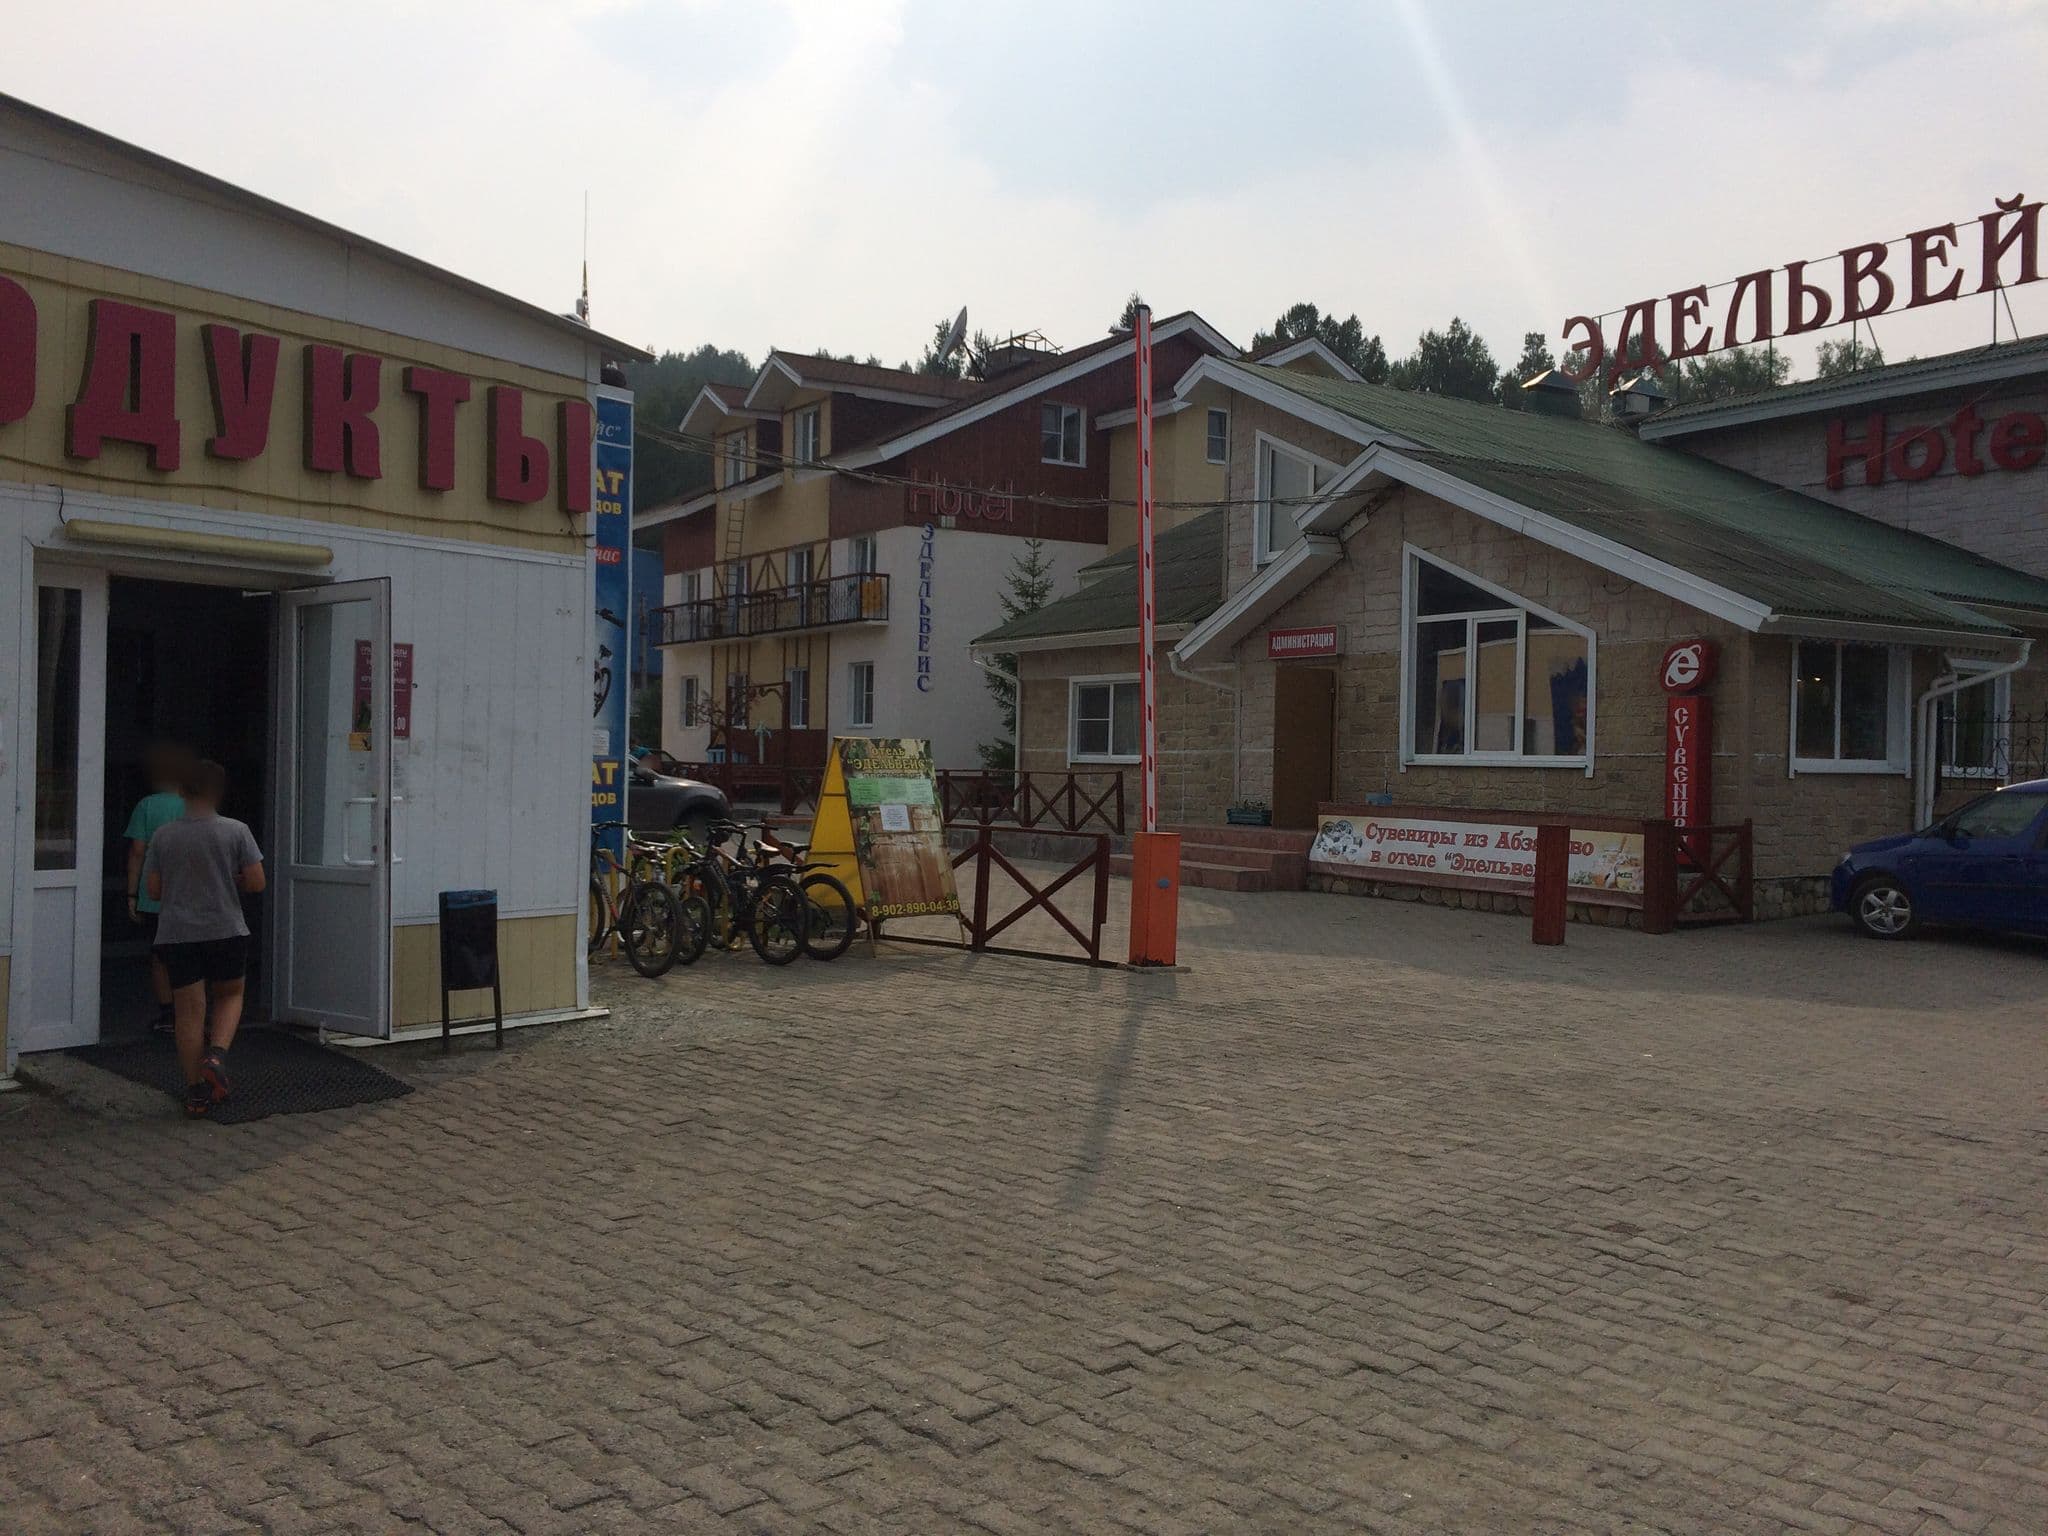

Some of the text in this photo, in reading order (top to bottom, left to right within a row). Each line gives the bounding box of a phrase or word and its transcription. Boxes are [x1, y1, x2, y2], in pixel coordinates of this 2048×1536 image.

[909, 466, 1014, 522] Hotel
[1272, 633, 1334, 651] АДМИНИСТРАЦИЯ
[1365, 822, 1458, 848] Сувениры
[1463, 832, 1489, 848] из
[1369, 850, 1381, 863] в
[1387, 851, 1437, 868] отеле
[871, 900, 959, 917] 8-902-890-04-38
